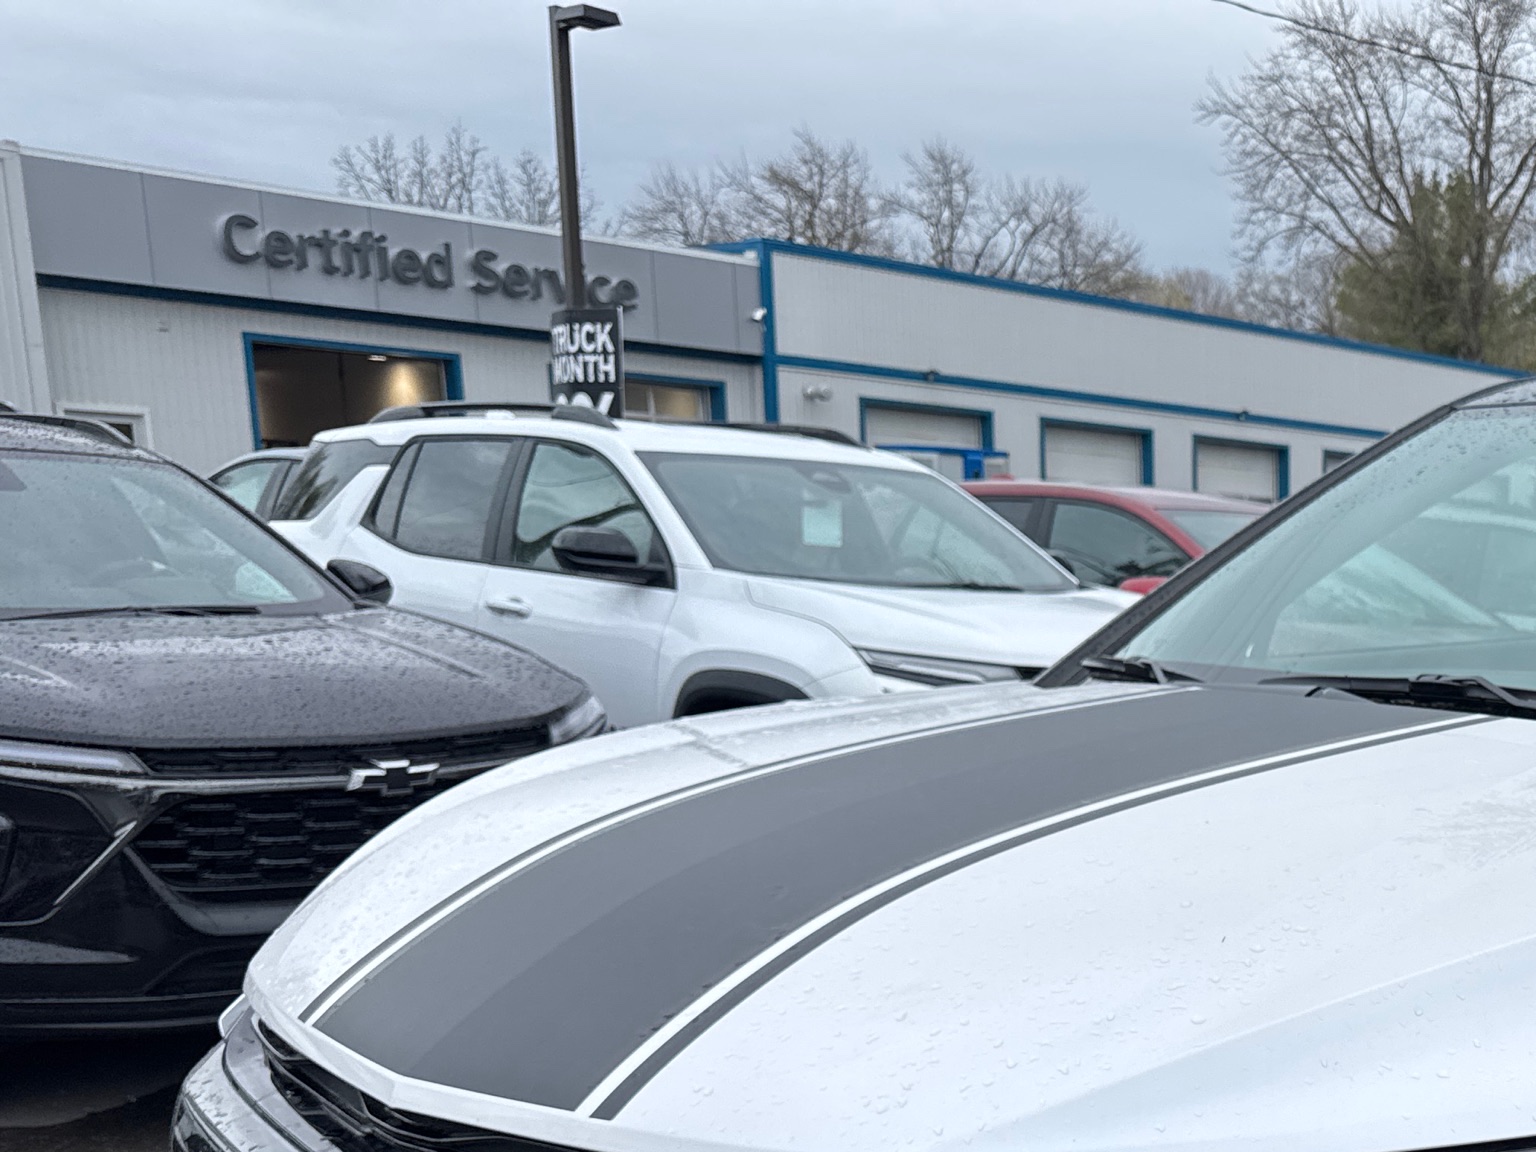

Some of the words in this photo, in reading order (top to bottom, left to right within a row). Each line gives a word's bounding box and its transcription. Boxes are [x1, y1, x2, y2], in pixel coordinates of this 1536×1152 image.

[223, 214, 455, 290] Certified
[471, 249, 639, 312] Servce
[551, 321, 616, 354] TRUCK
[553, 353, 616, 385] MONTH
